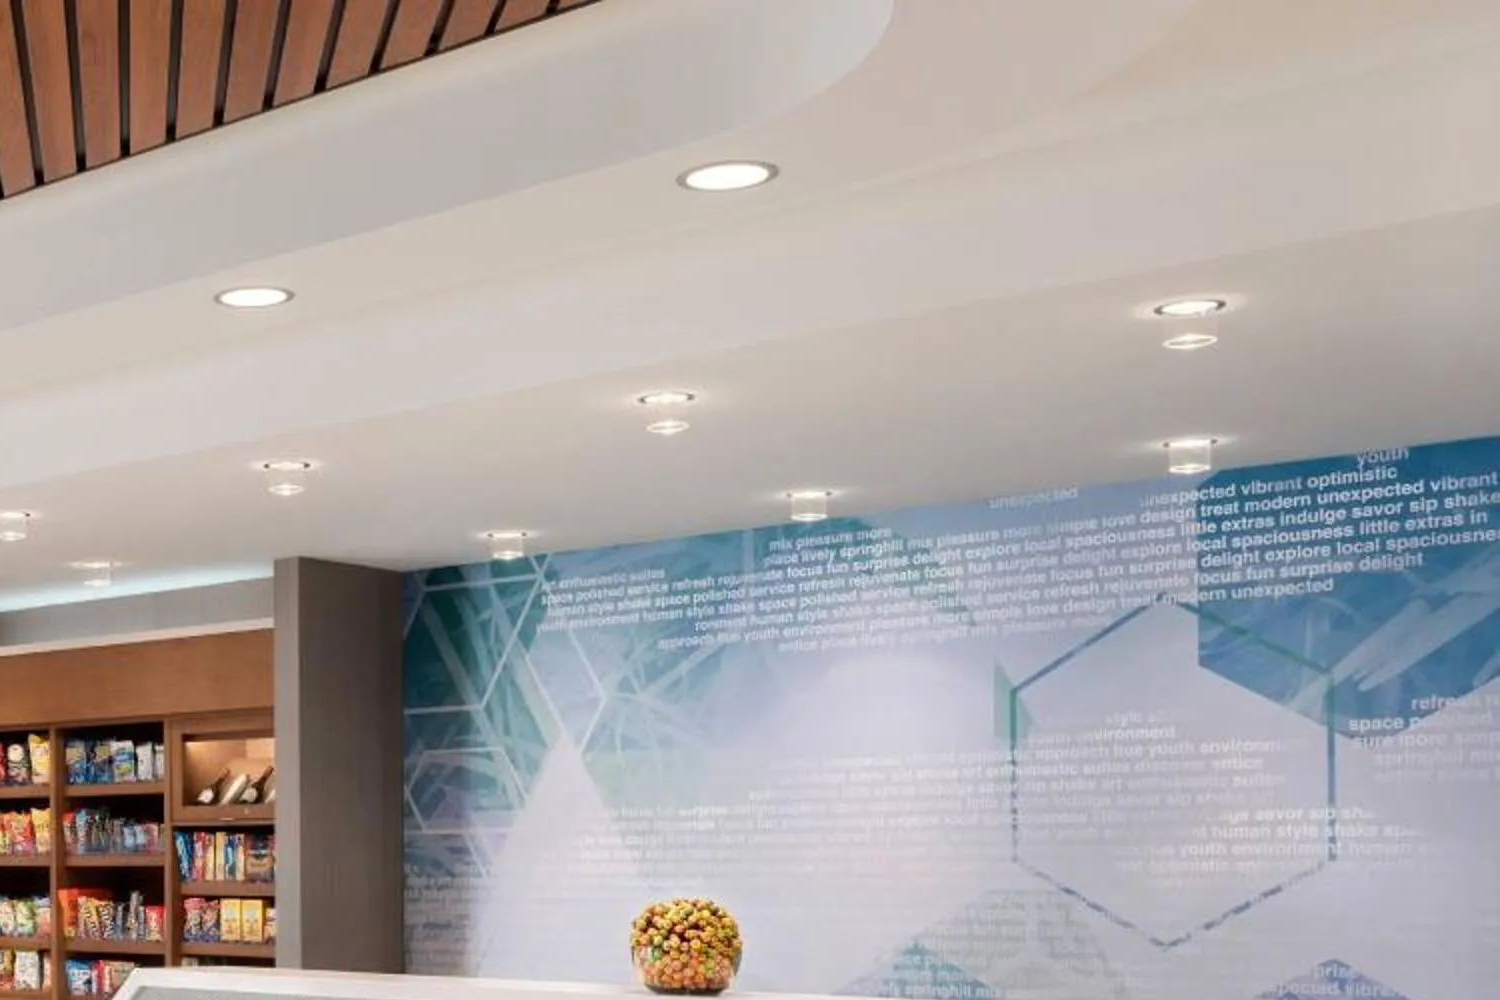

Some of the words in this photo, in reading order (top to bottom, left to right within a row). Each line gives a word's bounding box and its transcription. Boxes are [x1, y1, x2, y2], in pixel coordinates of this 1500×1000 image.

[1140, 482, 1235, 507] unexpected
[1240, 475, 1301, 496] vibrant
[1307, 465, 1397, 491] optimistic
[787, 565, 822, 579] focus
[827, 561, 848, 574] fun
[853, 555, 908, 573] surprise
[913, 547, 960, 566] delight
[965, 543, 1021, 562] explore
[1025, 537, 1060, 553] local
[1066, 527, 1175, 552] spaciousness
[1181, 521, 1215, 537] little
[1221, 517, 1274, 533] extras
[1280, 508, 1345, 527] indulge
[1351, 503, 1402, 520] savor
[1409, 498, 1437, 517] sip
[1444, 491, 1500, 510] shake
[801, 546, 836, 562] lively
[840, 538, 902, 560] springhill
[937, 530, 998, 551] pleasure
[1102, 514, 1135, 529] love
[1140, 507, 1194, 525] design
[1199, 500, 1238, 518] treat
[1245, 495, 1310, 513] modern
[1317, 479, 1423, 505] unexpected
[1430, 471, 1498, 493] vibrant
[924, 565, 963, 579] focus
[968, 562, 991, 575] fun
[996, 555, 1057, 574] surprise
[1062, 547, 1115, 567] delight
[1120, 543, 1181, 562] explore
[1187, 536, 1226, 553] local
[1231, 526, 1353, 553] spaciousness
[1359, 519, 1399, 537] little
[1405, 515, 1463, 532] extras
[1470, 510, 1487, 526] in
[1050, 568, 1092, 583] focus
[1098, 565, 1123, 578] fun
[1129, 558, 1195, 577] surprise
[1201, 550, 1258, 570] delight
[1265, 545, 1330, 565] explore
[1336, 538, 1379, 556] local
[1194, 571, 1240, 586] focus
[1246, 567, 1273, 582] fun
[1279, 560, 1353, 581] surprise
[1359, 552, 1421, 573] delight
[1231, 578, 1333, 601] unexpected
[1348, 717, 1403, 736] space
